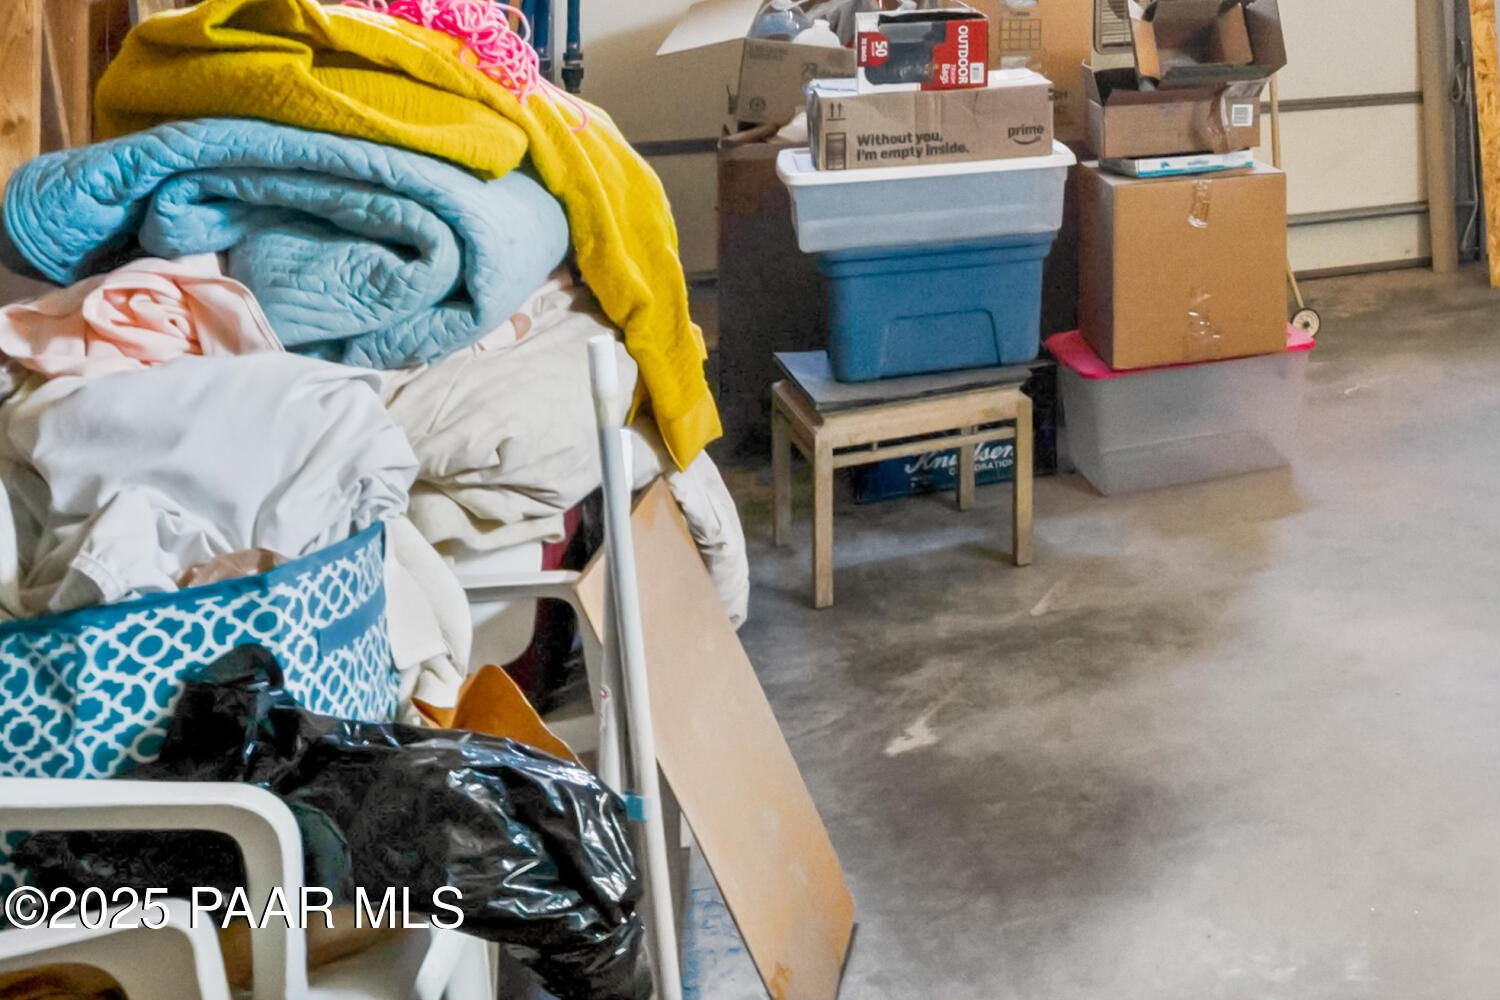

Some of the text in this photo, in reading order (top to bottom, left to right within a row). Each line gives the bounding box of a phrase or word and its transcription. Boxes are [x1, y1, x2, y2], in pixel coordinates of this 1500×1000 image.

[875, 40, 888, 58] 50
[958, 24, 969, 85] OUTDOOR
[857, 132, 913, 147] Without
[1007, 125, 1045, 139] prime
[857, 149, 878, 161] I'm
[880, 146, 923, 160] empty
